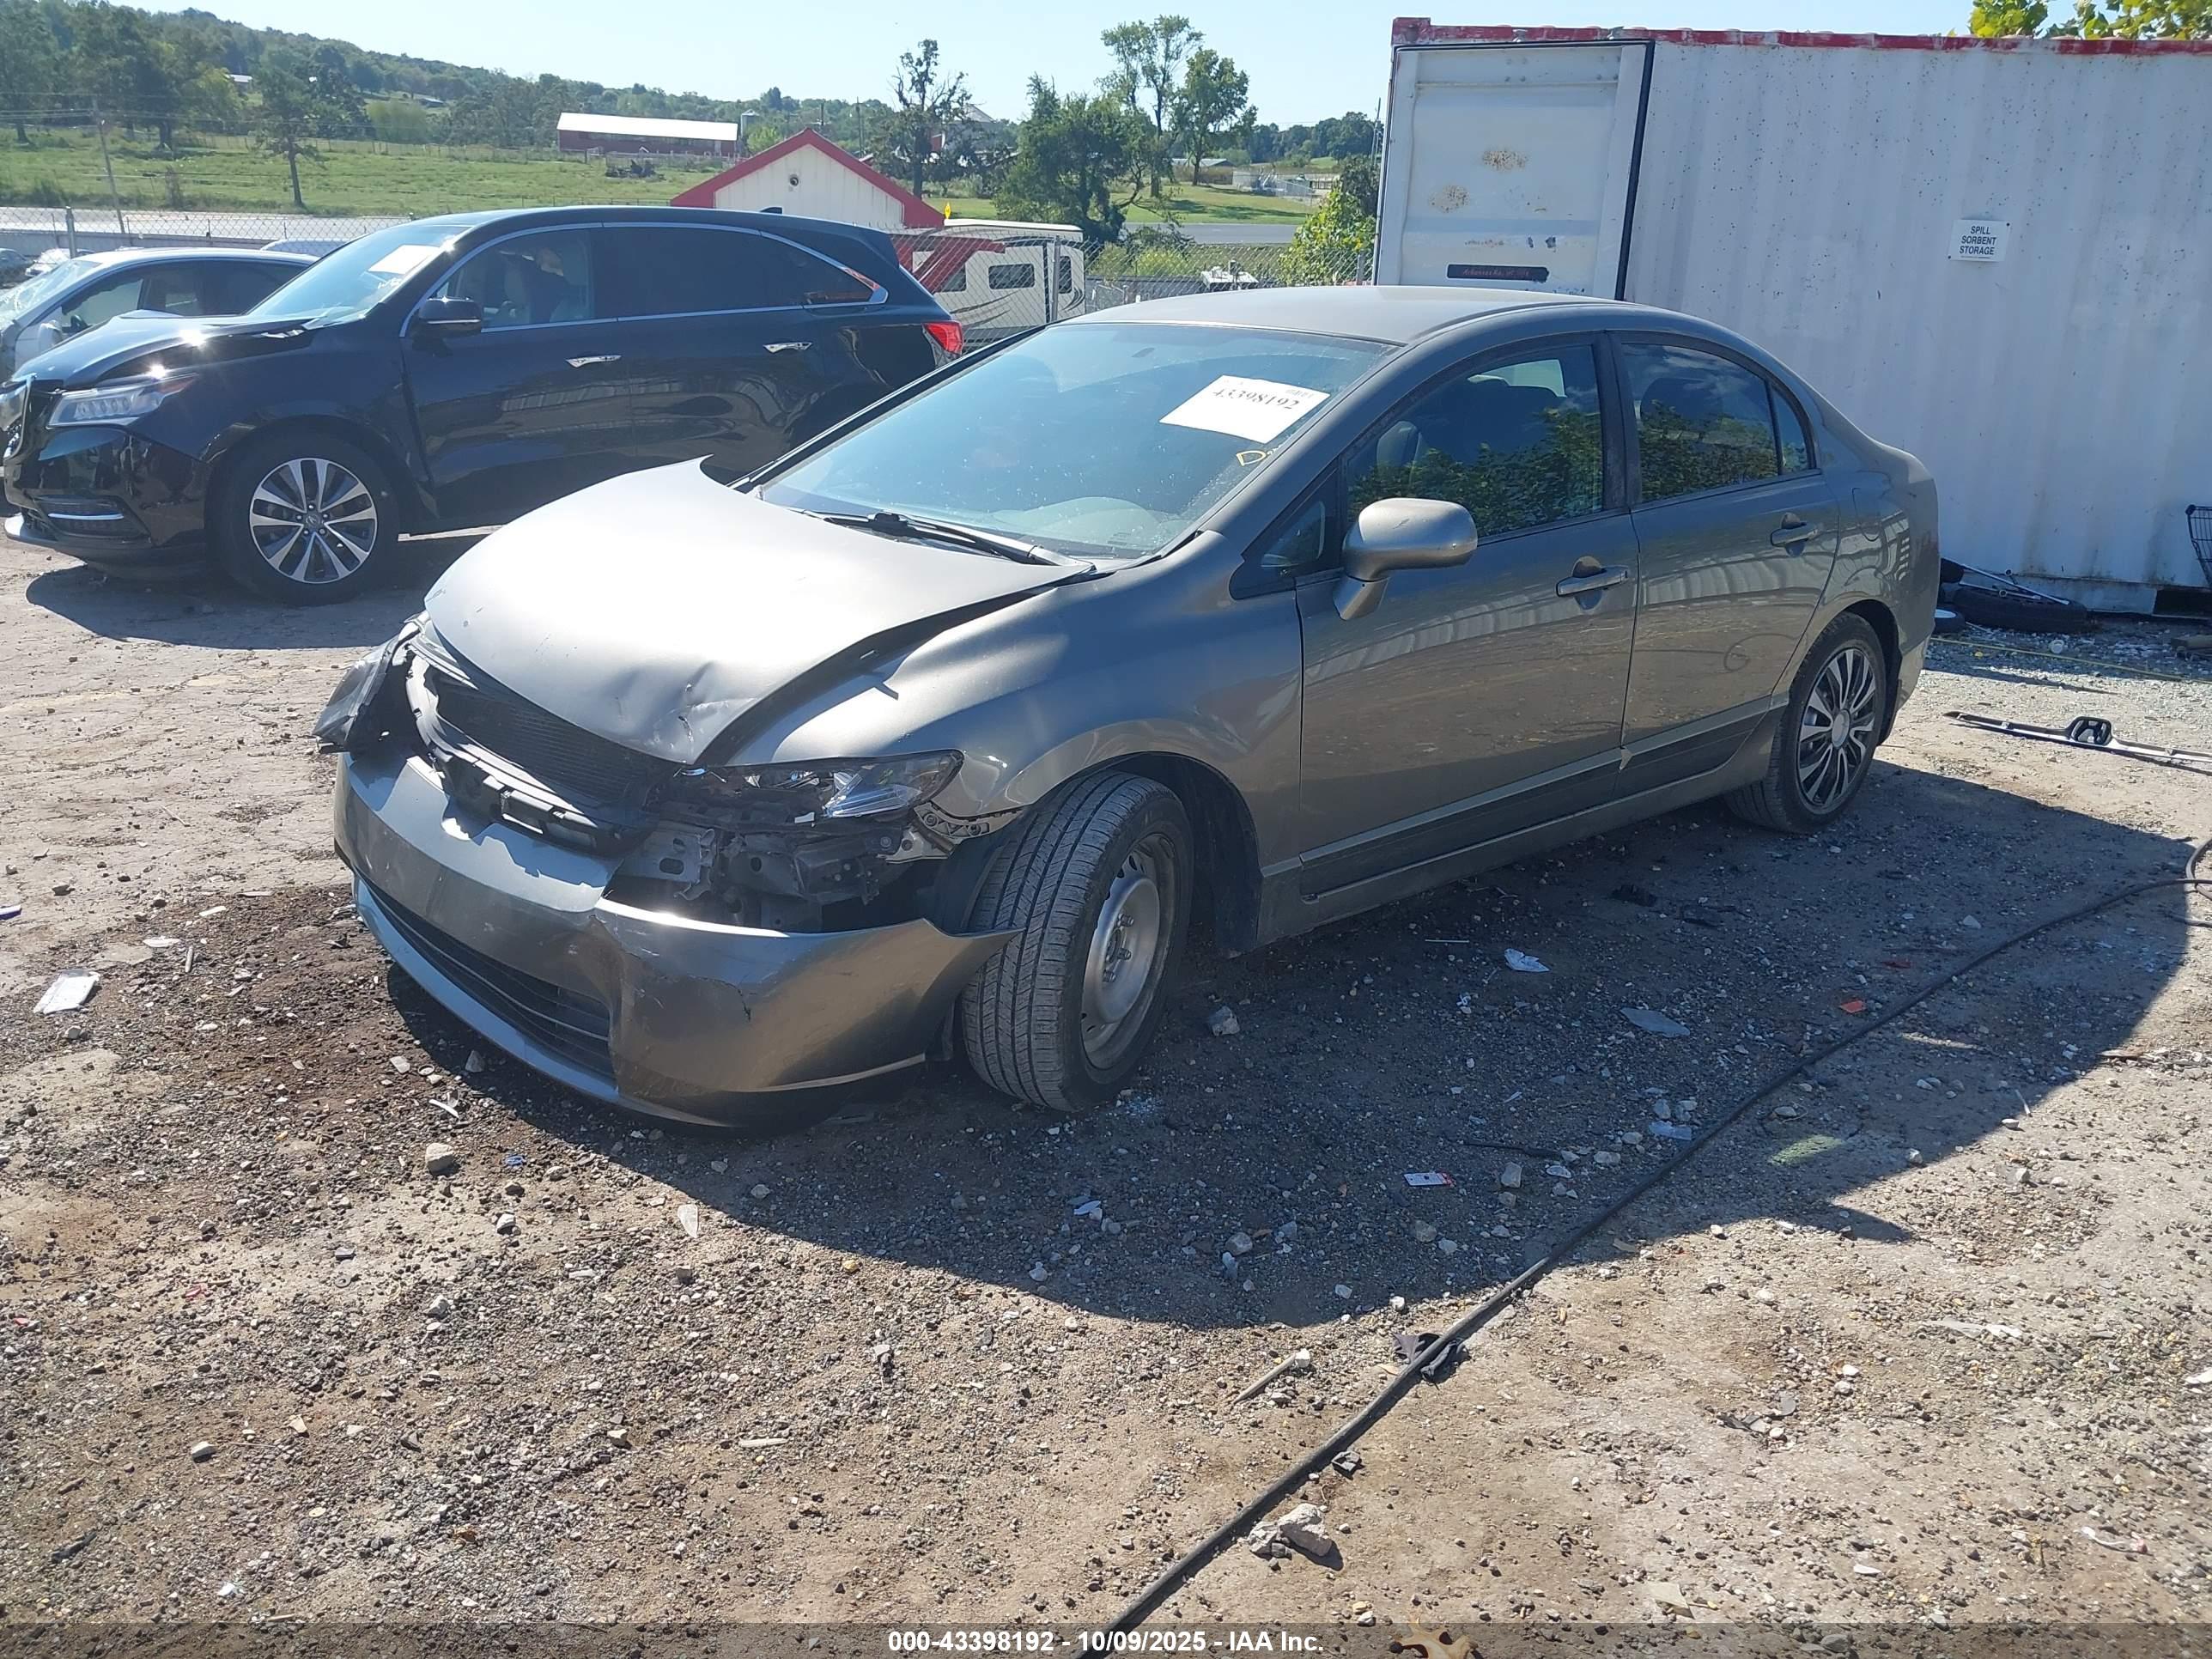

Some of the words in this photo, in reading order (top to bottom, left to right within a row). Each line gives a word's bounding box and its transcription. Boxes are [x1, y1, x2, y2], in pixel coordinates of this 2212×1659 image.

[1970, 226, 1991, 234] SPILL
[1961, 235, 1996, 245] SORBENT
[1959, 246, 1995, 255] STORAGE
[1212, 388, 1300, 410] 43398192
